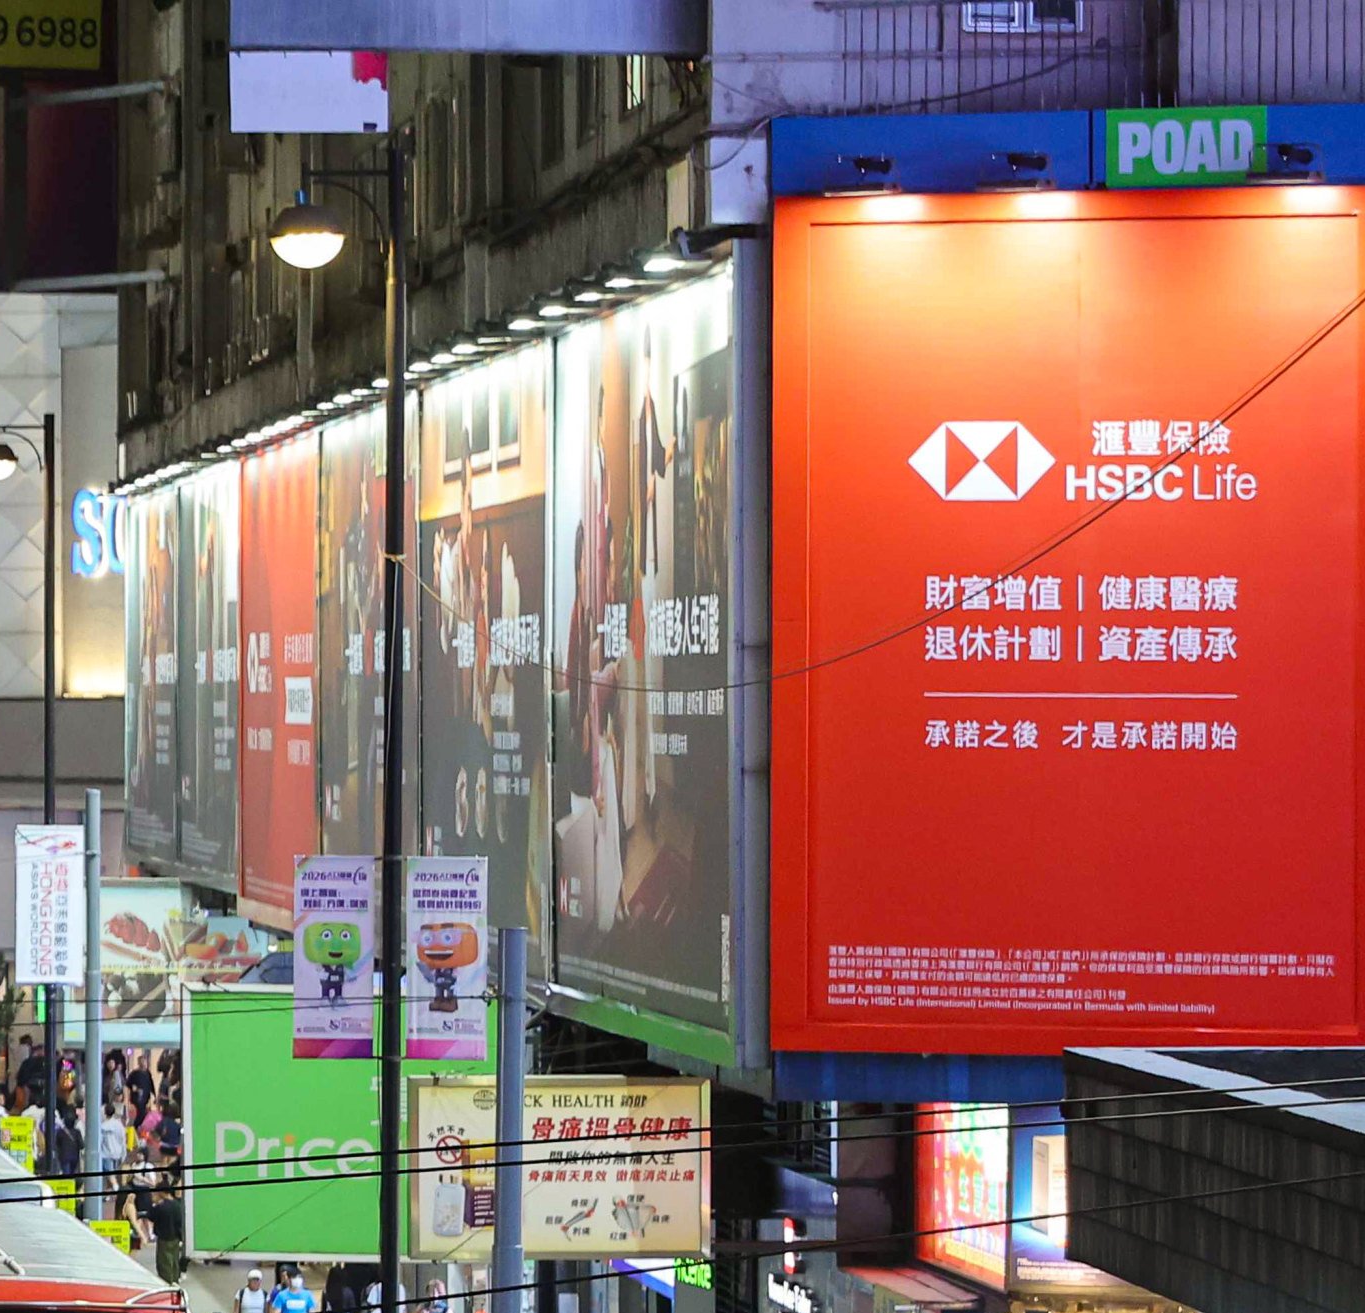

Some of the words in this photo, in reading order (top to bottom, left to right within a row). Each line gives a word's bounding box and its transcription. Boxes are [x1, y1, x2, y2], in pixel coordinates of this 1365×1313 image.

[15, 12, 99, 49] 6988
[1117, 119, 1254, 176] POAD
[1065, 465, 1183, 502] HSBC
[1194, 463, 1258, 502] Life
[924, 575, 1062, 612] 財富增值
[1098, 575, 1238, 612] 健康醫療
[924, 625, 1062, 662] 退休計劃
[1098, 625, 1238, 662] 資產傳承
[924, 720, 1039, 749] 承諾之後
[1061, 721, 1238, 752] 才是承諾開始
[39, 862, 54, 917] HONG
[39, 920, 54, 976] KONG
[857, 997, 869, 1007] by
[871, 997, 896, 1006] HSBC
[552, 1095, 614, 1108] HEALTH
[213, 1121, 376, 1177] Price
